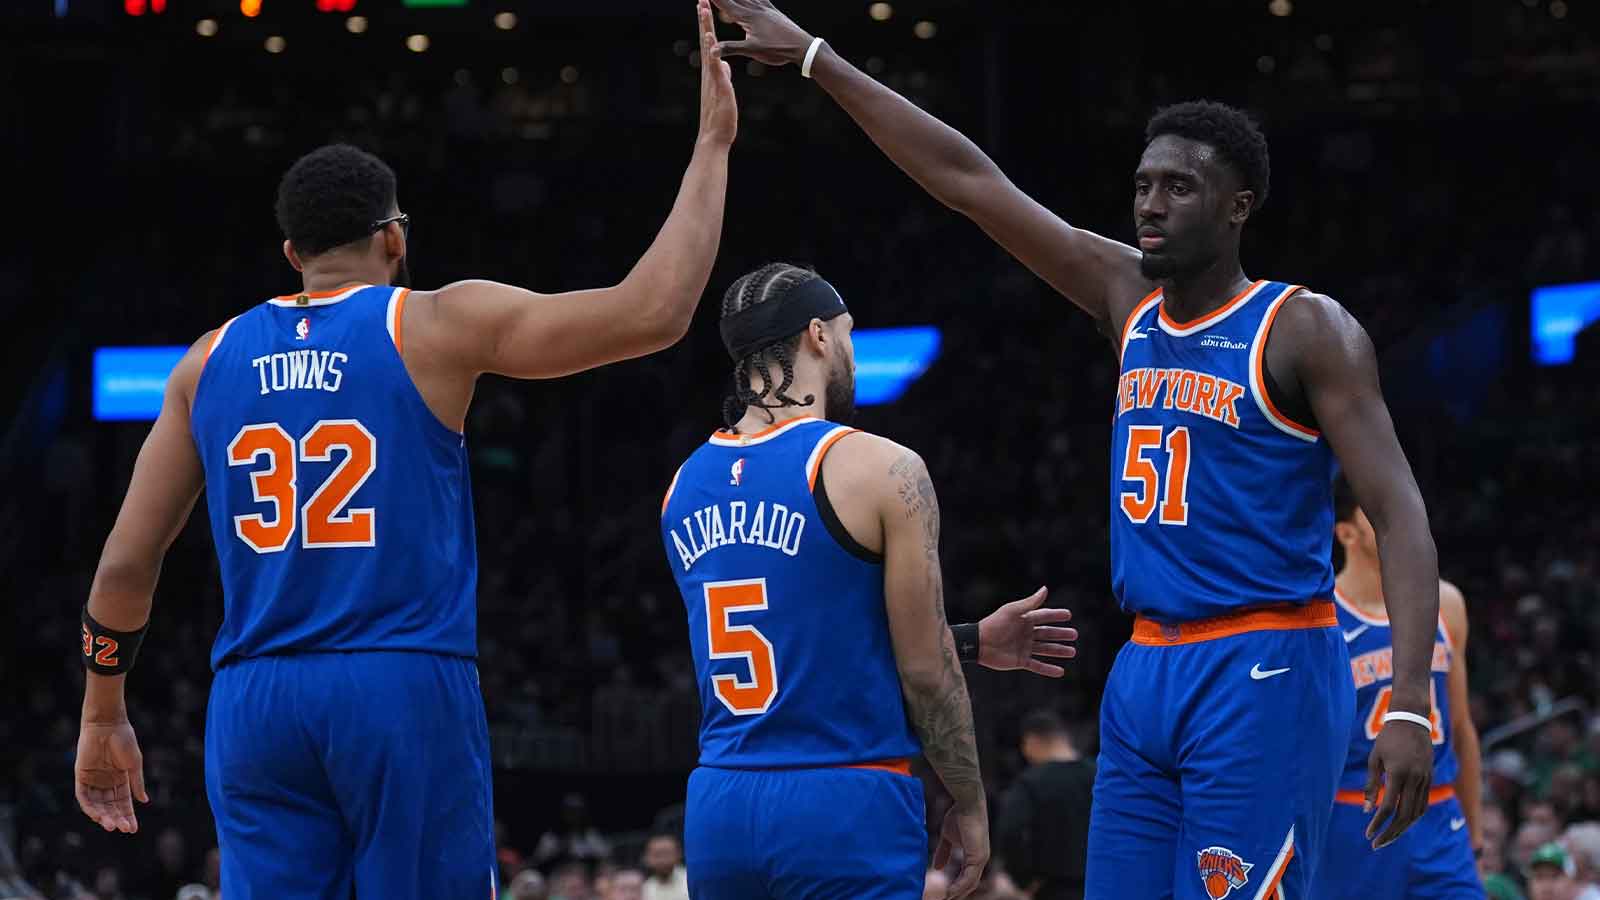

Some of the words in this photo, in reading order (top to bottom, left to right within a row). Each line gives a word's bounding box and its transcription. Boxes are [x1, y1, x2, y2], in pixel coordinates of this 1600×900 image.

[252, 349, 348, 395] TOWNS
[1201, 338, 1219, 348] abu
[1220, 340, 1249, 351] dhabi
[1117, 367, 1166, 418] NEW
[1162, 367, 1246, 430] YORK
[227, 419, 377, 554] 32
[1120, 425, 1191, 526] 51
[670, 500, 806, 571] ALVARADO
[703, 577, 778, 716] 5
